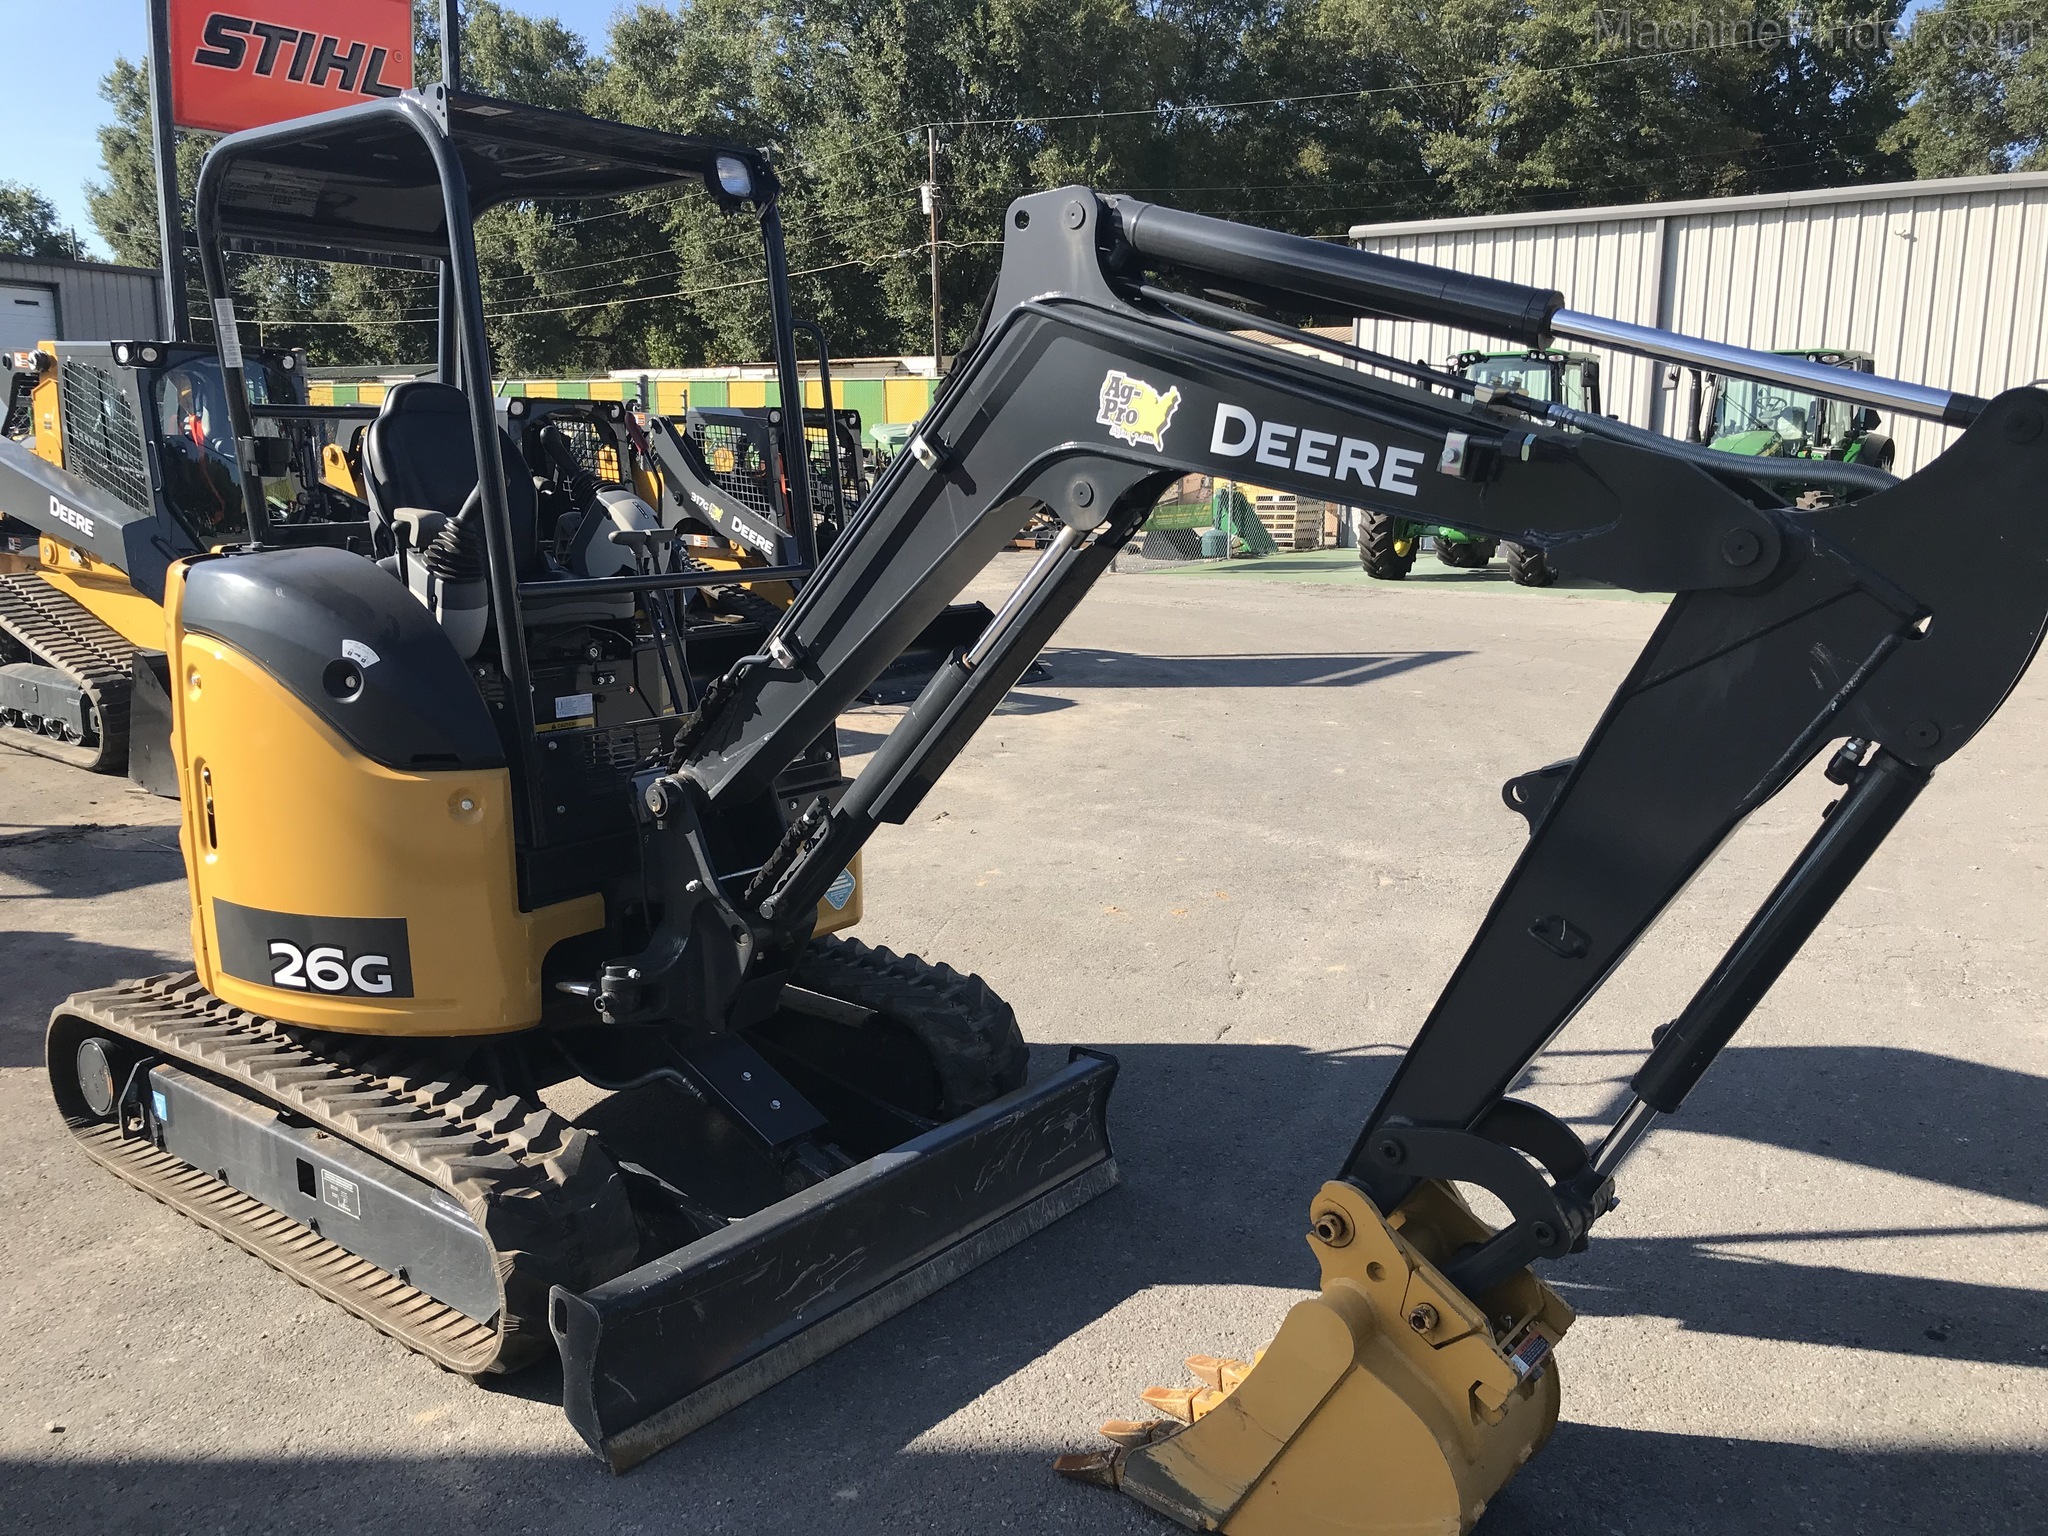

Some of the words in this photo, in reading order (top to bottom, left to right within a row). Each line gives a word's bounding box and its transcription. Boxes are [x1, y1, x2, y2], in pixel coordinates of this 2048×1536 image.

[192, 11, 404, 99] STIHL
[1101, 398, 1138, 424] Pro
[1105, 376, 1142, 405] Ag-
[1210, 402, 1425, 496] DEERE
[49, 495, 94, 538] DEERE
[690, 492, 709, 510] 317G
[731, 516, 774, 555] DEERE
[270, 942, 393, 994] 26G
